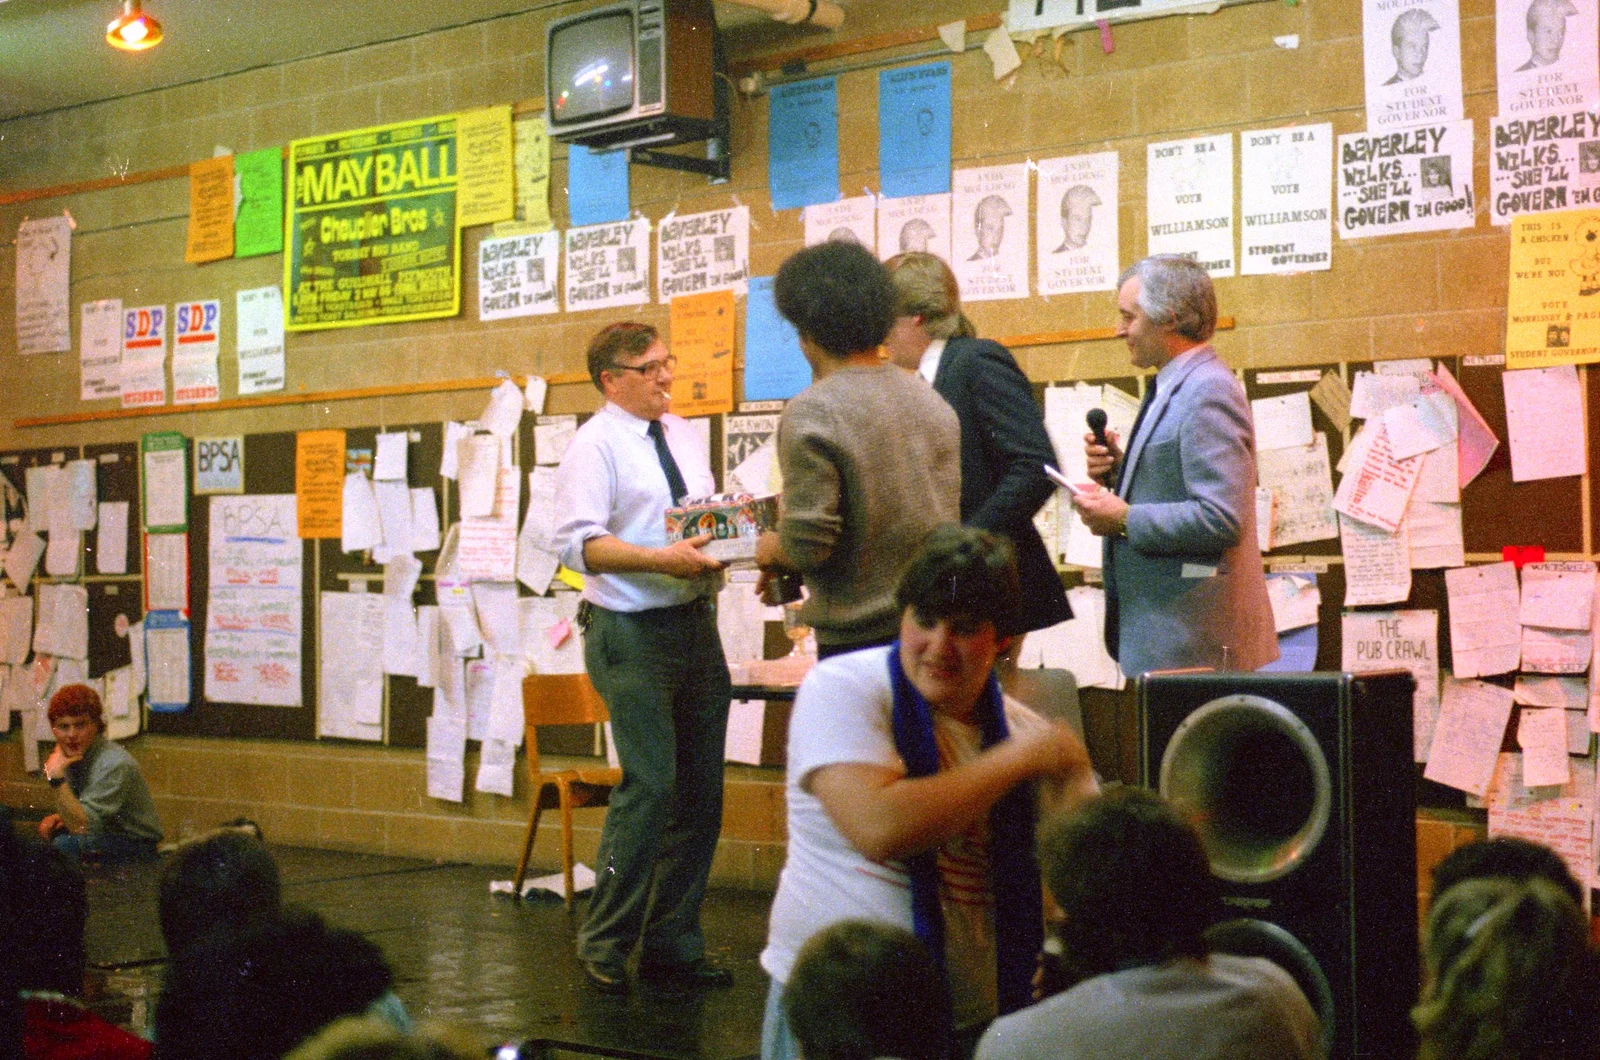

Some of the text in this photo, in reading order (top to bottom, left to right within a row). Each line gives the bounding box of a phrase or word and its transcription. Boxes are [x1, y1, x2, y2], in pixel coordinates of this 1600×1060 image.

[1537, 72, 1564, 84] FOR
[1404, 86, 1428, 96] FOR
[1519, 83, 1580, 99] STUDENT
[1386, 95, 1443, 111] STUDENT
[1510, 95, 1584, 113] GOVERNOR
[1377, 106, 1447, 125] GOVERNOR
[1250, 131, 1315, 147] DON'T BE A
[1495, 111, 1600, 148] BEVERLEY
[1155, 142, 1216, 159] DON'T BE A
[1342, 126, 1448, 165] BEVERLEY
[303, 156, 374, 205] MAY
[375, 143, 457, 196] BALL
[1175, 193, 1203, 204] VOTE
[1271, 183, 1301, 195] VOTE
[1496, 186, 1567, 217] GOVERN
[1244, 208, 1328, 228] WILLIAMSON
[1344, 201, 1411, 230] GOVERN
[1150, 217, 1230, 237] WILLIAMSON
[1530, 234, 1569, 243] CHICKEN
[1248, 243, 1296, 256] STUDENT
[125, 308, 163, 339] SDP
[177, 303, 217, 334] SDP
[1510, 349, 1548, 359] STUDENT
[198, 440, 240, 473] BPSA
[1377, 618, 1402, 637] THE
[1356, 640, 1432, 661] PUB CRAWL
